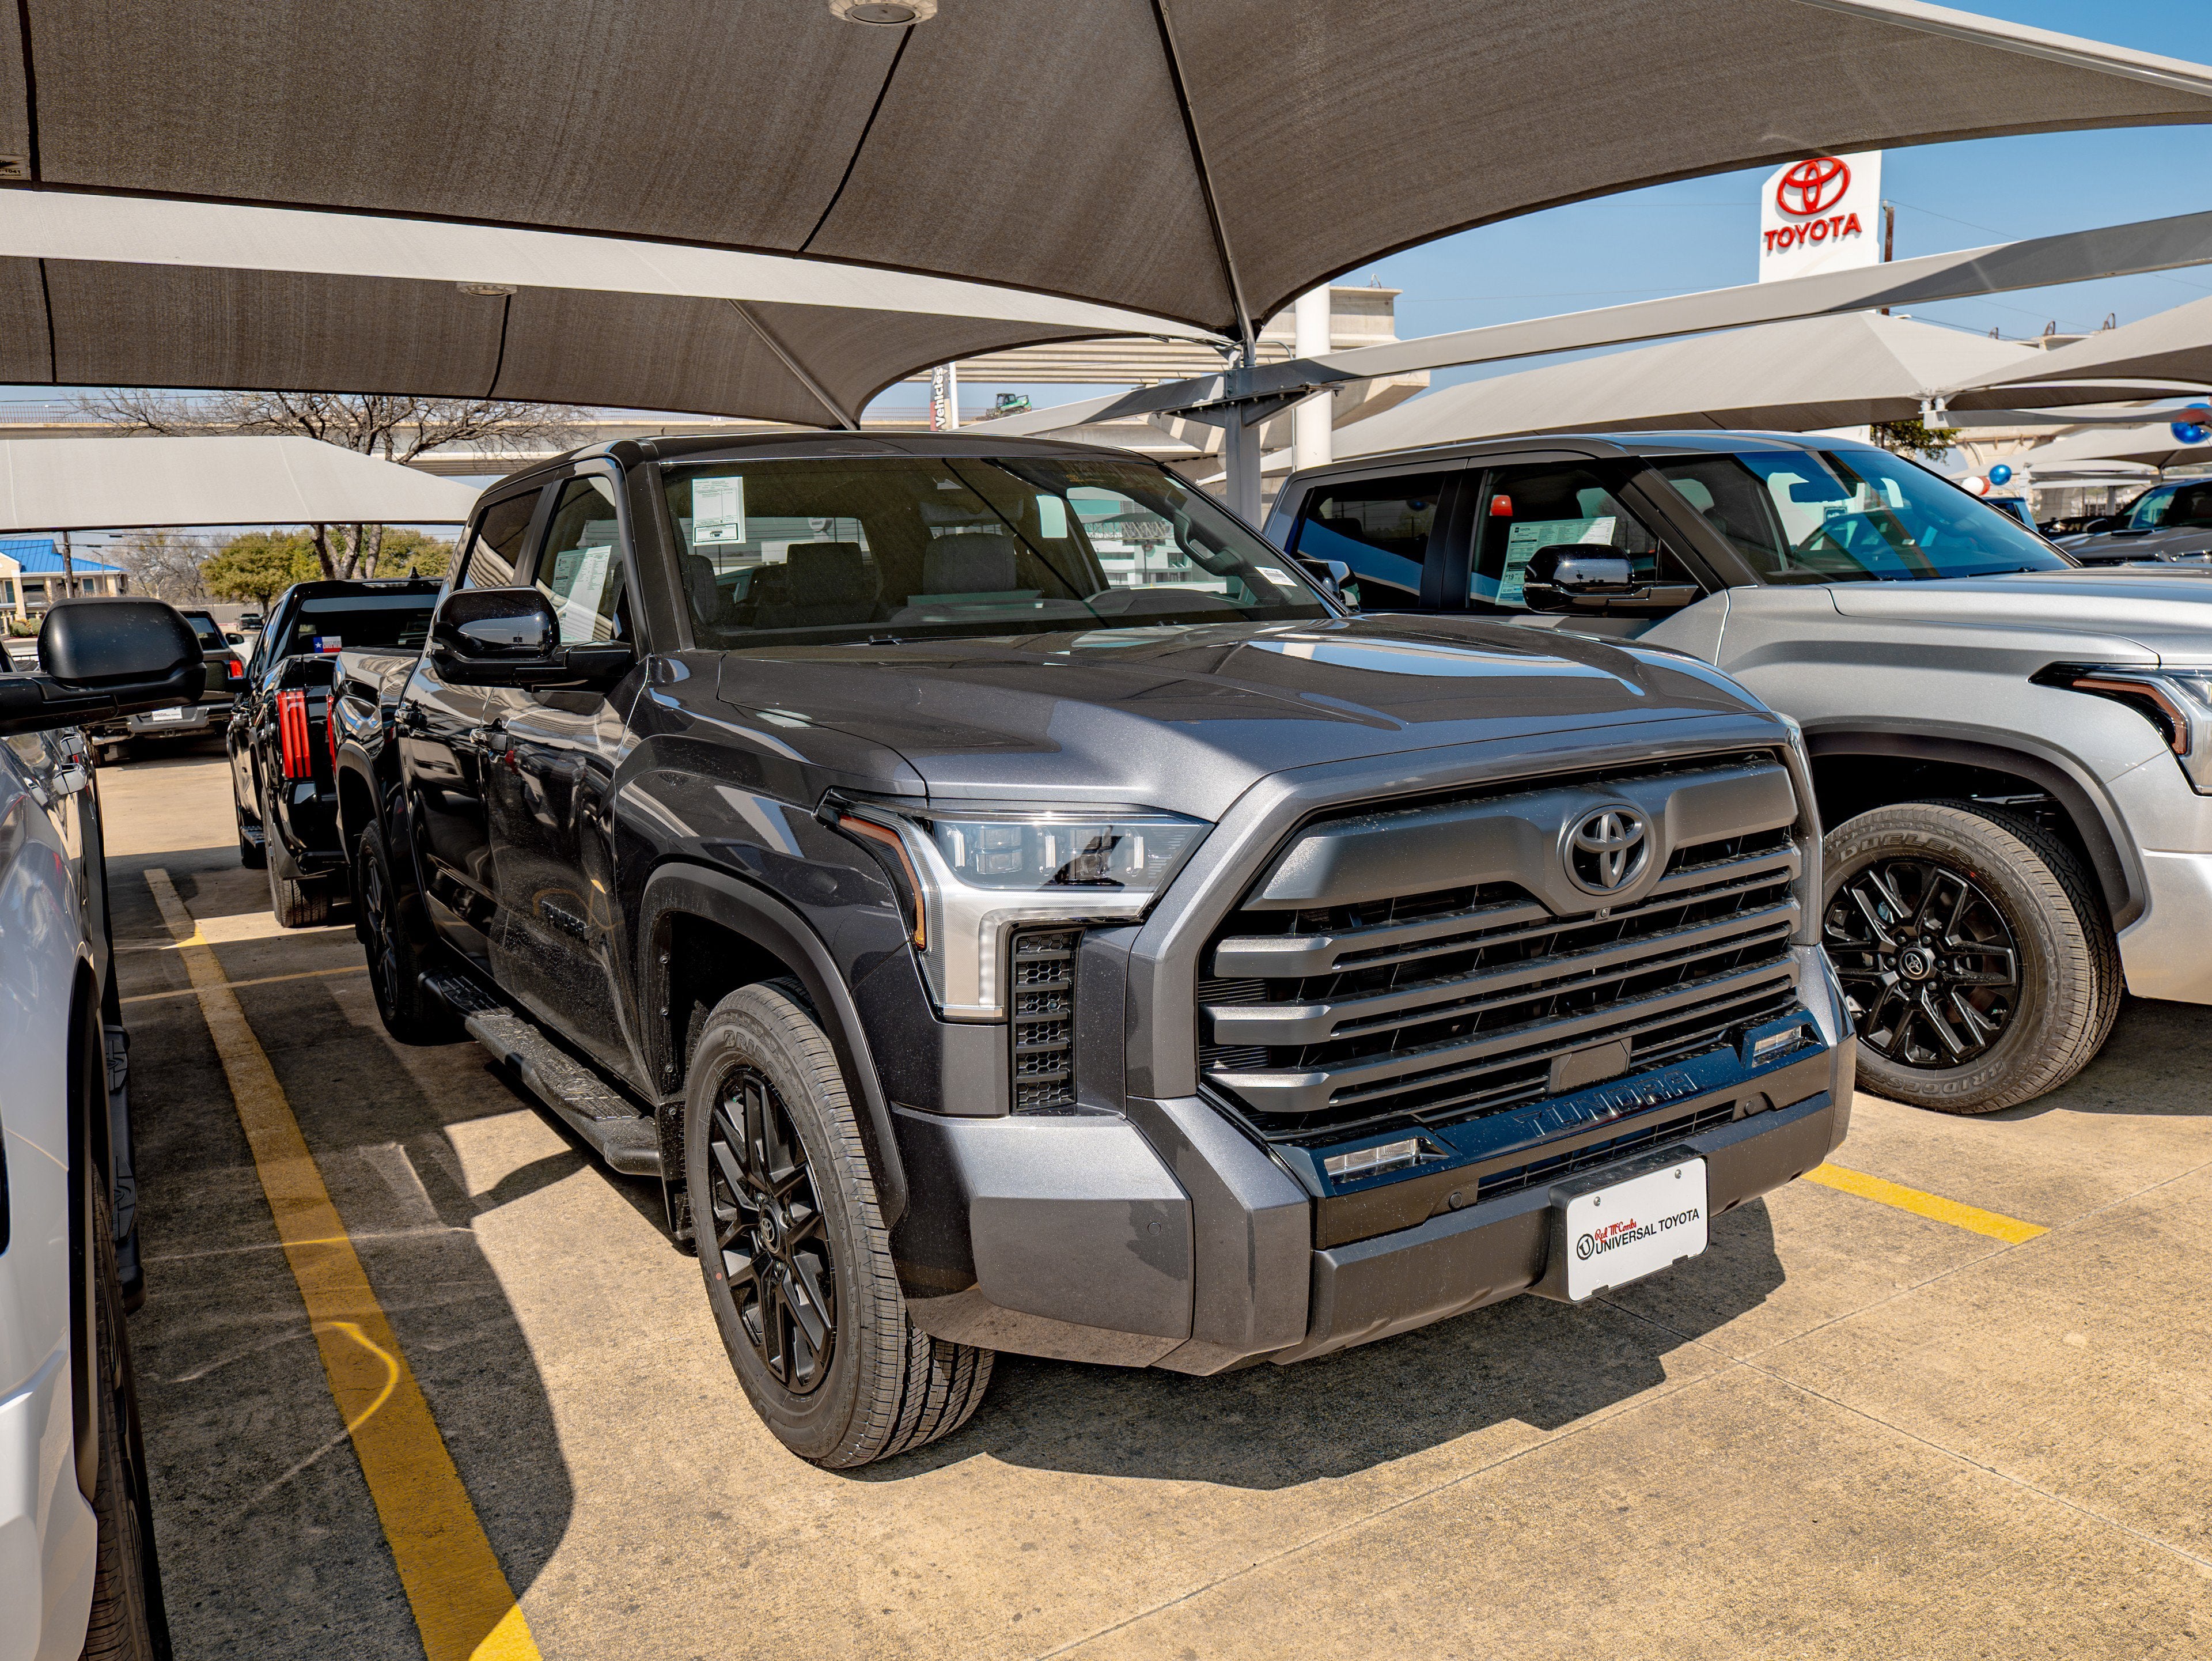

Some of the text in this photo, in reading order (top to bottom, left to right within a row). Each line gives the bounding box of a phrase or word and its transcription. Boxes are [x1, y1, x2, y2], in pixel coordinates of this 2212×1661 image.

[1764, 213, 1862, 251] TOYOTA
[934, 367, 946, 427] Vehicles
[1839, 833, 1974, 865] DUELER
[1856, 1059, 2007, 1095] BRIDGESTO
[1511, 1070, 1698, 1138] TUNDRA
[1594, 1218, 1637, 1243] Red McCombs
[1596, 1208, 1699, 1254] UNIVERSAL TOYOTA
